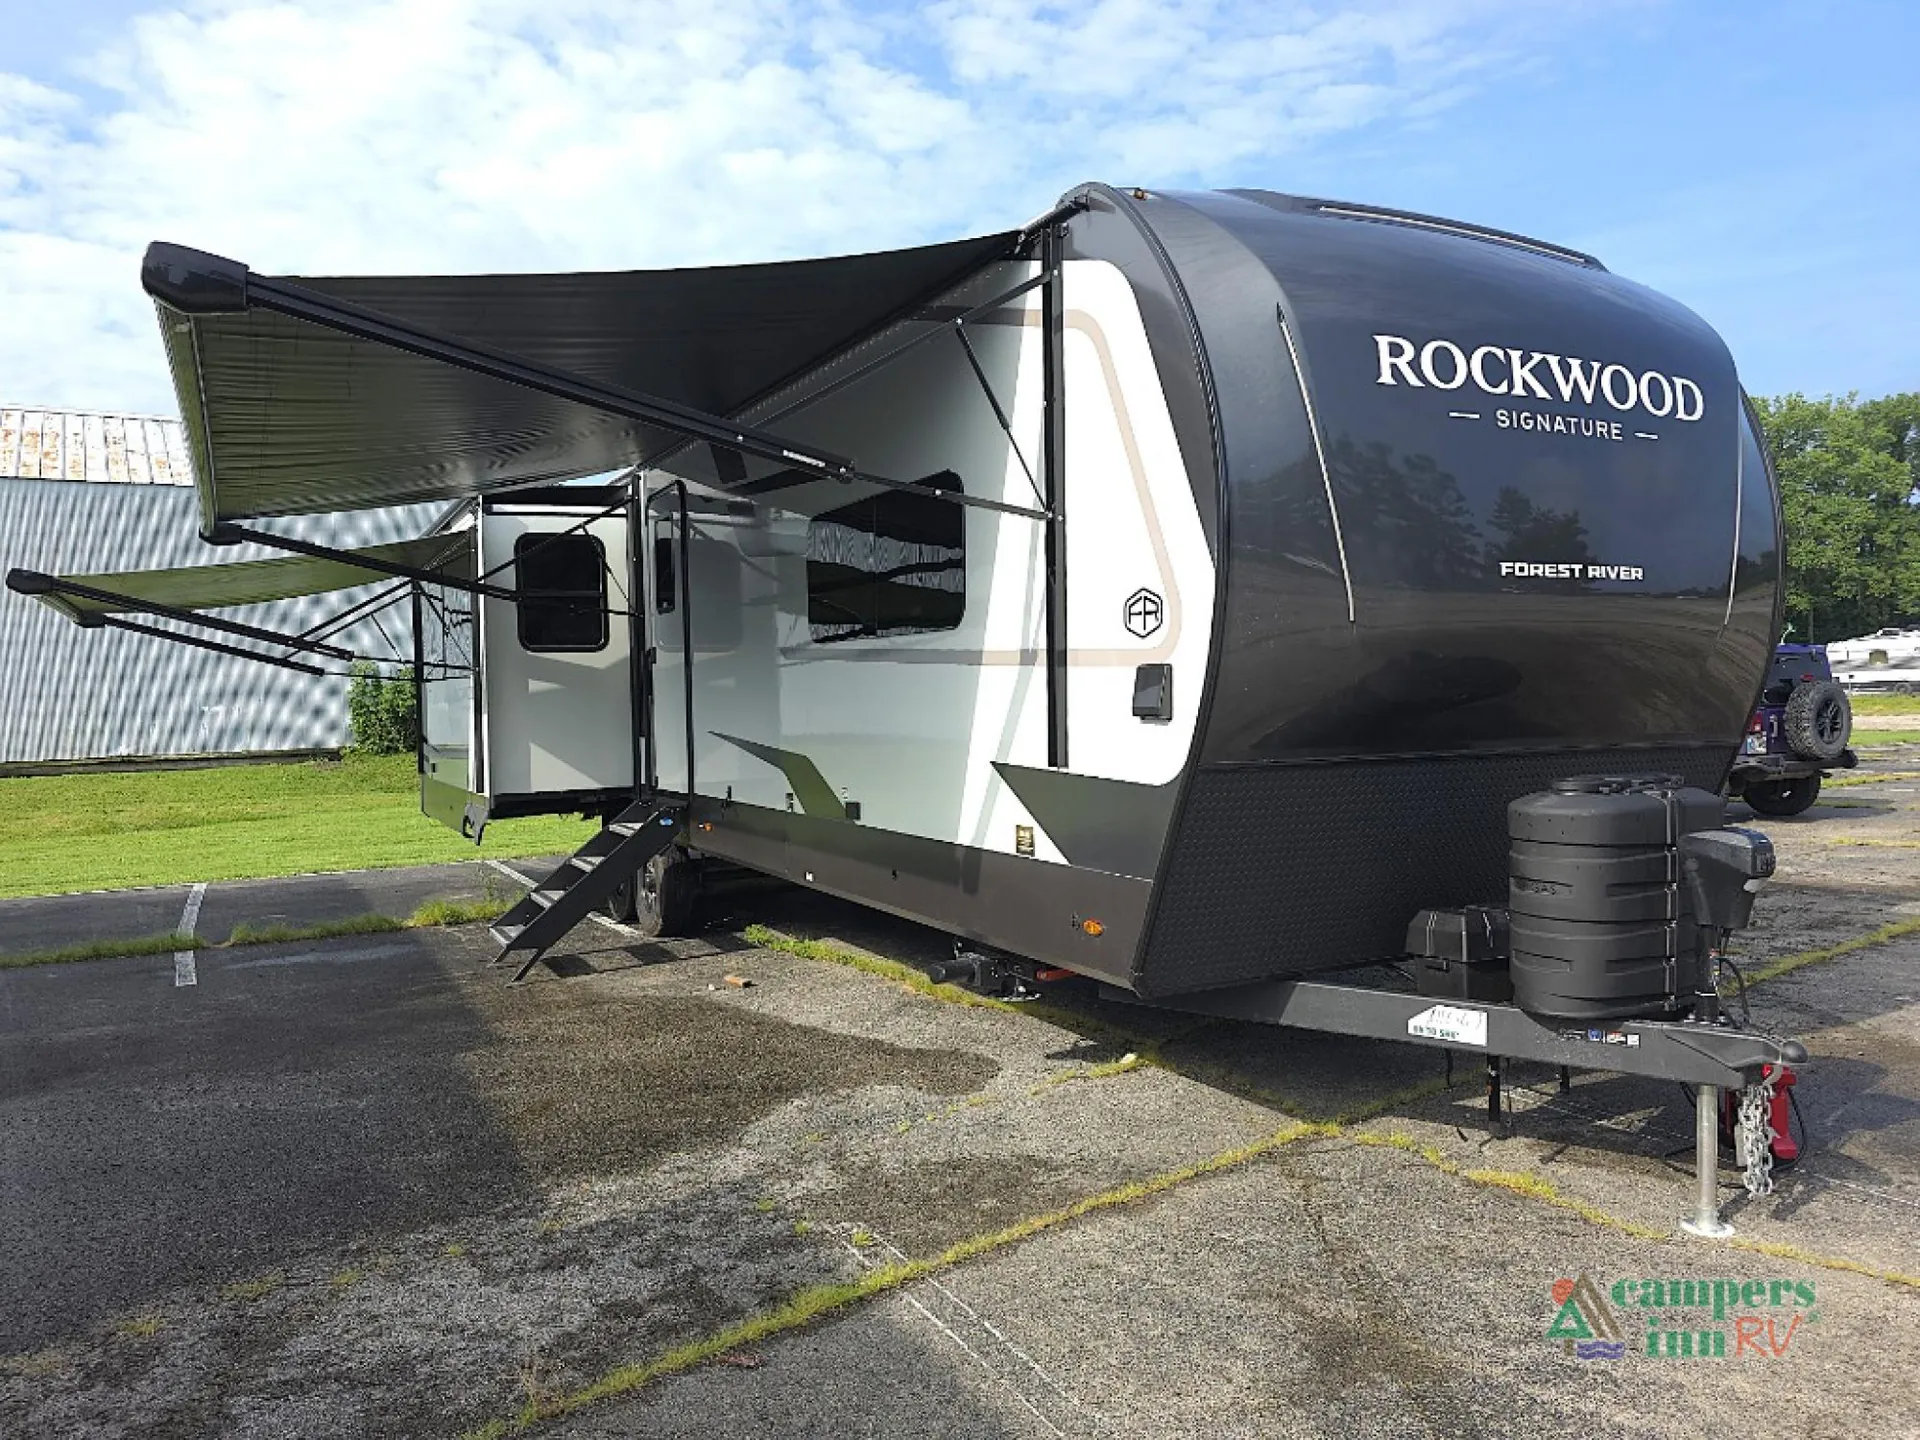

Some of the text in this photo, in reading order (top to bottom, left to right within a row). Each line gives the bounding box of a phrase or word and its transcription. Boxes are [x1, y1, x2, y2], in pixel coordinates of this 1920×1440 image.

[1372, 333, 1704, 422] ROCKWOOD
[1495, 409, 1624, 441] SIGNATURE
[1500, 561, 1644, 581] FOREST RIVER
